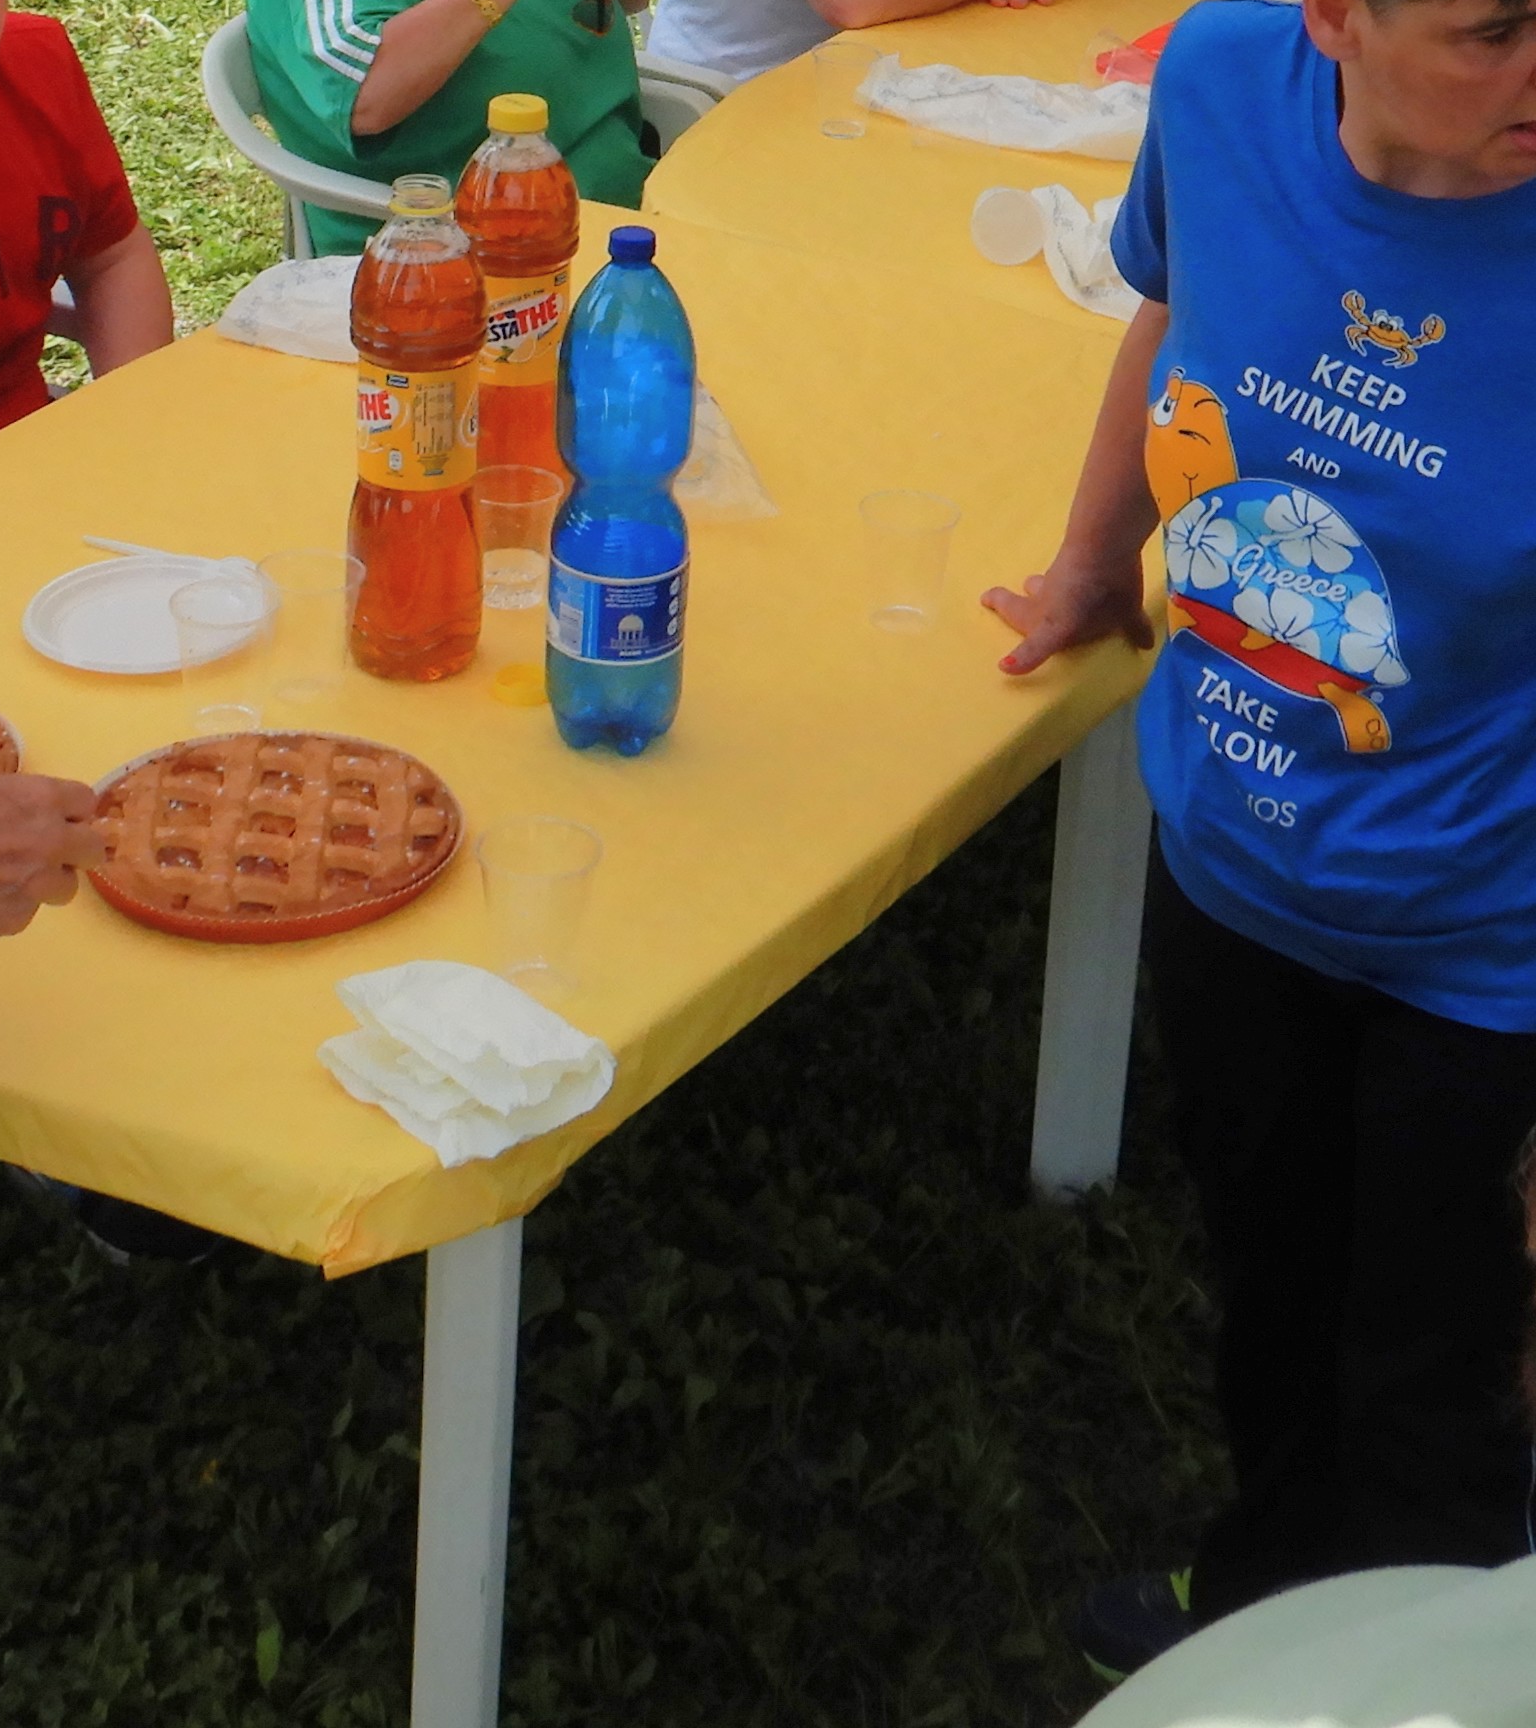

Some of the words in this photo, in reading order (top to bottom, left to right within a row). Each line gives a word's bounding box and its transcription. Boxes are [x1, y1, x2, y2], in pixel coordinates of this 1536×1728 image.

[1310, 353, 1407, 412] KEEP
[1236, 366, 1448, 479] SWIMMING
[1286, 447, 1341, 479] AND
[1232, 543, 1347, 602] Greece
[1196, 666, 1279, 733] TAKE
[1196, 713, 1297, 778] LOW
